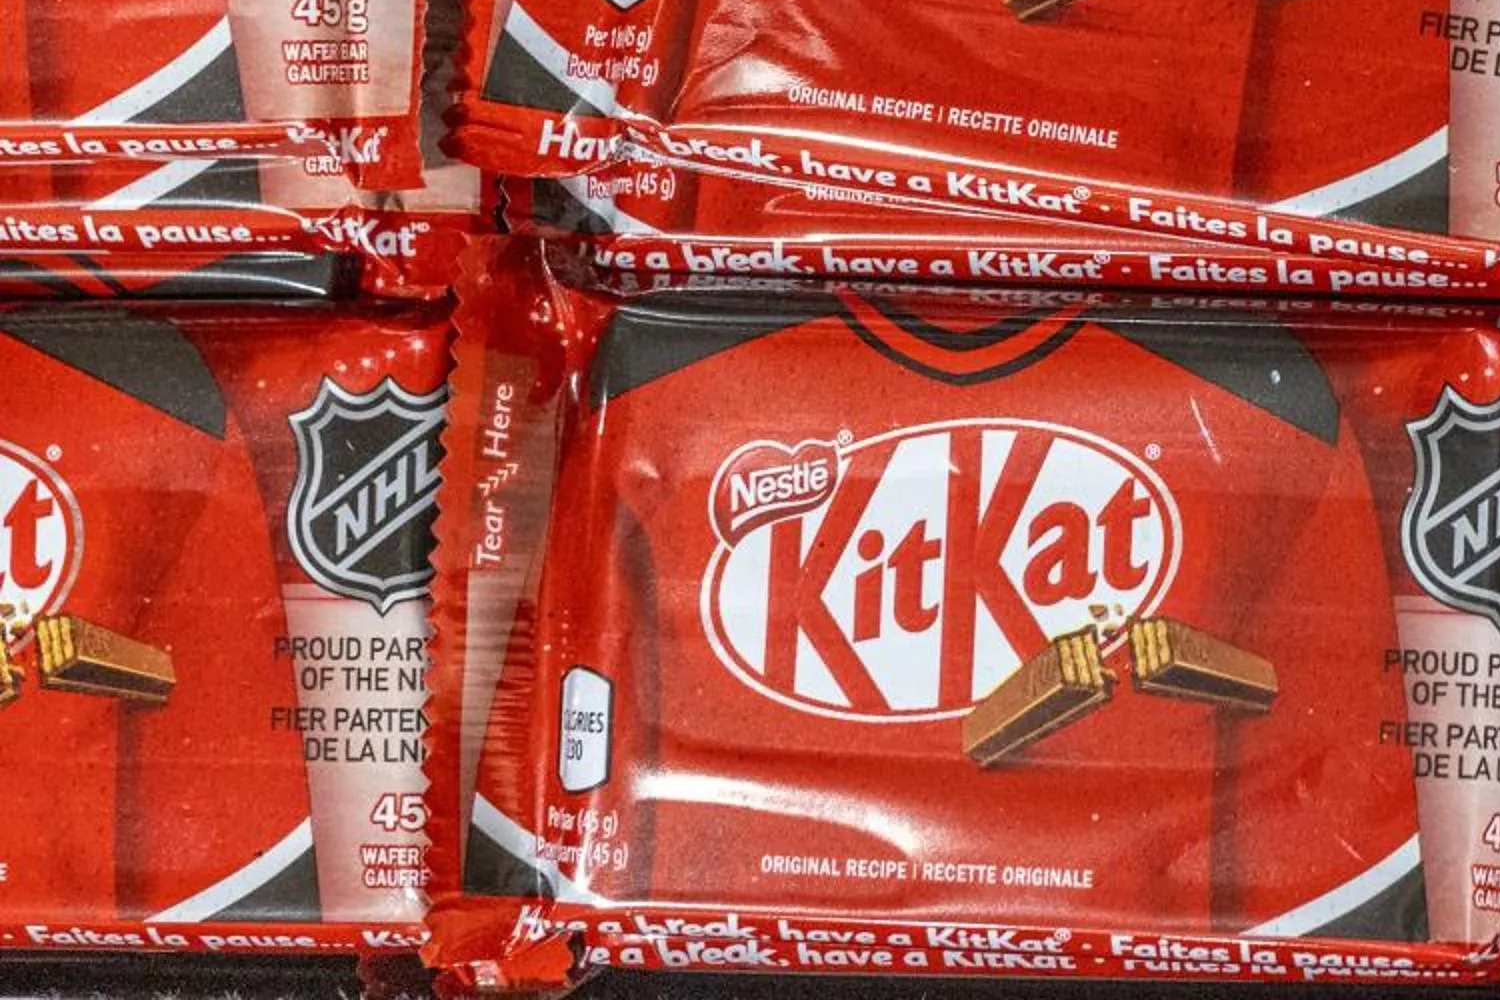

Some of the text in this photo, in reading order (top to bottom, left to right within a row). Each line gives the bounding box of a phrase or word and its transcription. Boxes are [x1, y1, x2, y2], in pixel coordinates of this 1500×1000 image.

[1420, 12, 1478, 41] FIER
[283, 40, 337, 63] WAFER
[1452, 47, 1488, 73] DE
[788, 85, 1119, 150] ORIGINAL RECIPE RECETTE ORIGINALE
[63, 132, 107, 156] la
[801, 150, 897, 187] have
[907, 175, 932, 193] a
[1129, 197, 1247, 243] Faites
[1256, 217, 1294, 246] la
[84, 216, 124, 244] la
[822, 247, 1314, 288] have Faites la
[476, 384, 514, 565] Tear Here
[336, 440, 442, 557] NHL
[763, 430, 1151, 711] KitKat
[273, 637, 361, 663] PROUD
[1384, 649, 1479, 678] PROUD
[303, 667, 389, 691] OF THE
[1412, 682, 1448, 706] OF
[271, 708, 326, 733] FIER
[1379, 720, 1438, 747] FIER
[306, 738, 376, 762] DE LA
[1415, 754, 1491, 780] DE LA
[371, 793, 428, 832] 45
[360, 845, 419, 867] WAFER
[761, 855, 1094, 890] ORIGINAL RECIPE RECETTE ORIGINALE
[24, 925, 189, 949] Faites la
[778, 919, 1277, 965] have Faites la
[797, 947, 893, 968] have
